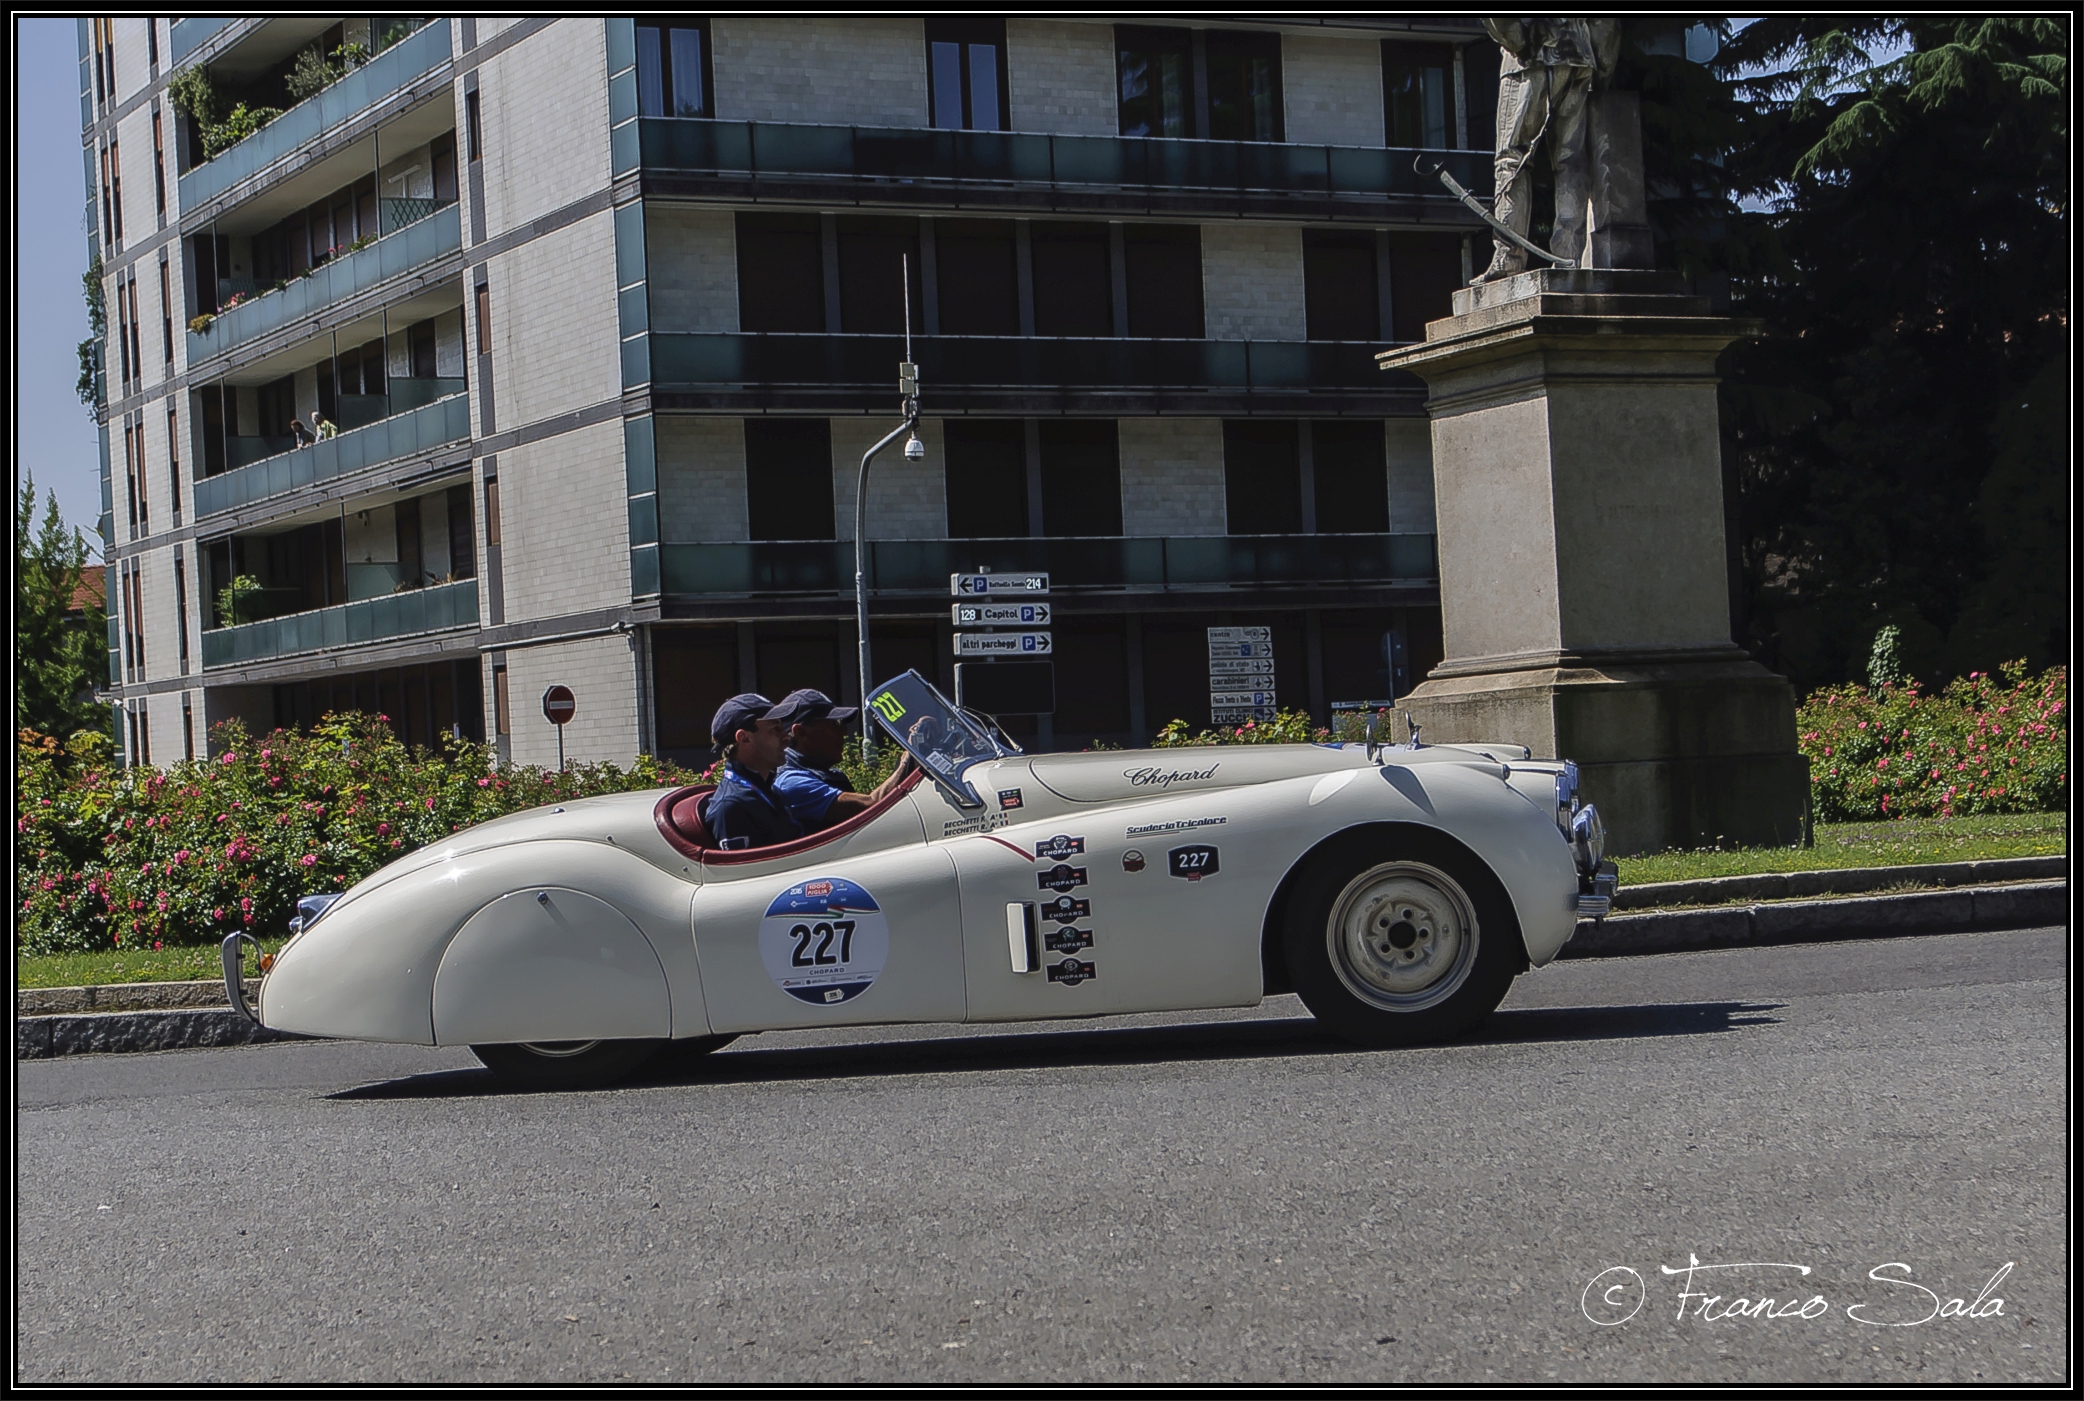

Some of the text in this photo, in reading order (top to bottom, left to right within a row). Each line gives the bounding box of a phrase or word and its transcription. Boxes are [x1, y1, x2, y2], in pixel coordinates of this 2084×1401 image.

[1026, 578, 1041, 590] 214
[961, 609, 976, 620] 128
[985, 608, 1018, 620] Capitol
[962, 640, 979, 649] altri
[982, 639, 1017, 650] parcheggi
[871, 691, 906, 722] 227
[1123, 763, 1220, 788] Chopard
[944, 817, 979, 829] BECCHETTI
[944, 825, 979, 836] BECCHETTI
[1043, 848, 1077, 856] CHOPARD
[1179, 852, 1209, 868] 227
[1046, 879, 1080, 887] CHOPARD
[789, 920, 856, 968] 227
[1053, 941, 1087, 949] CHOPARD
[809, 967, 845, 975] CHOPARD
